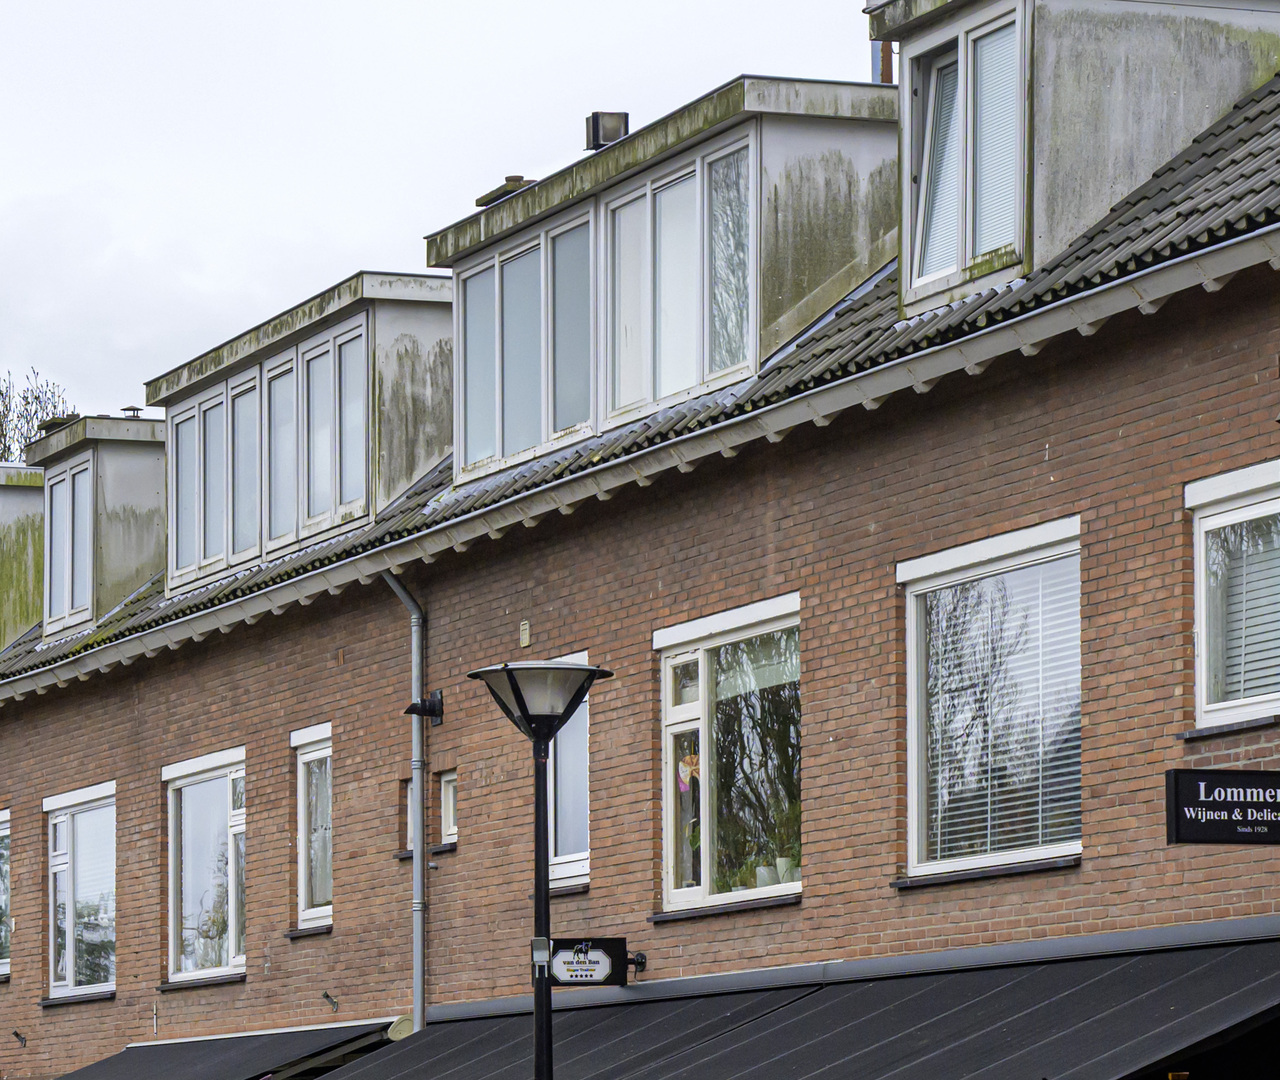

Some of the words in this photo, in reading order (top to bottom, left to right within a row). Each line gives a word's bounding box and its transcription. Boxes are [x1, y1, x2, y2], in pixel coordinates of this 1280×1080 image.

[1183, 807, 1228, 823] Wijnen
[1231, 808, 1243, 820] &
[1236, 825, 1253, 833] Sinds
[1254, 825, 1269, 833] 1928
